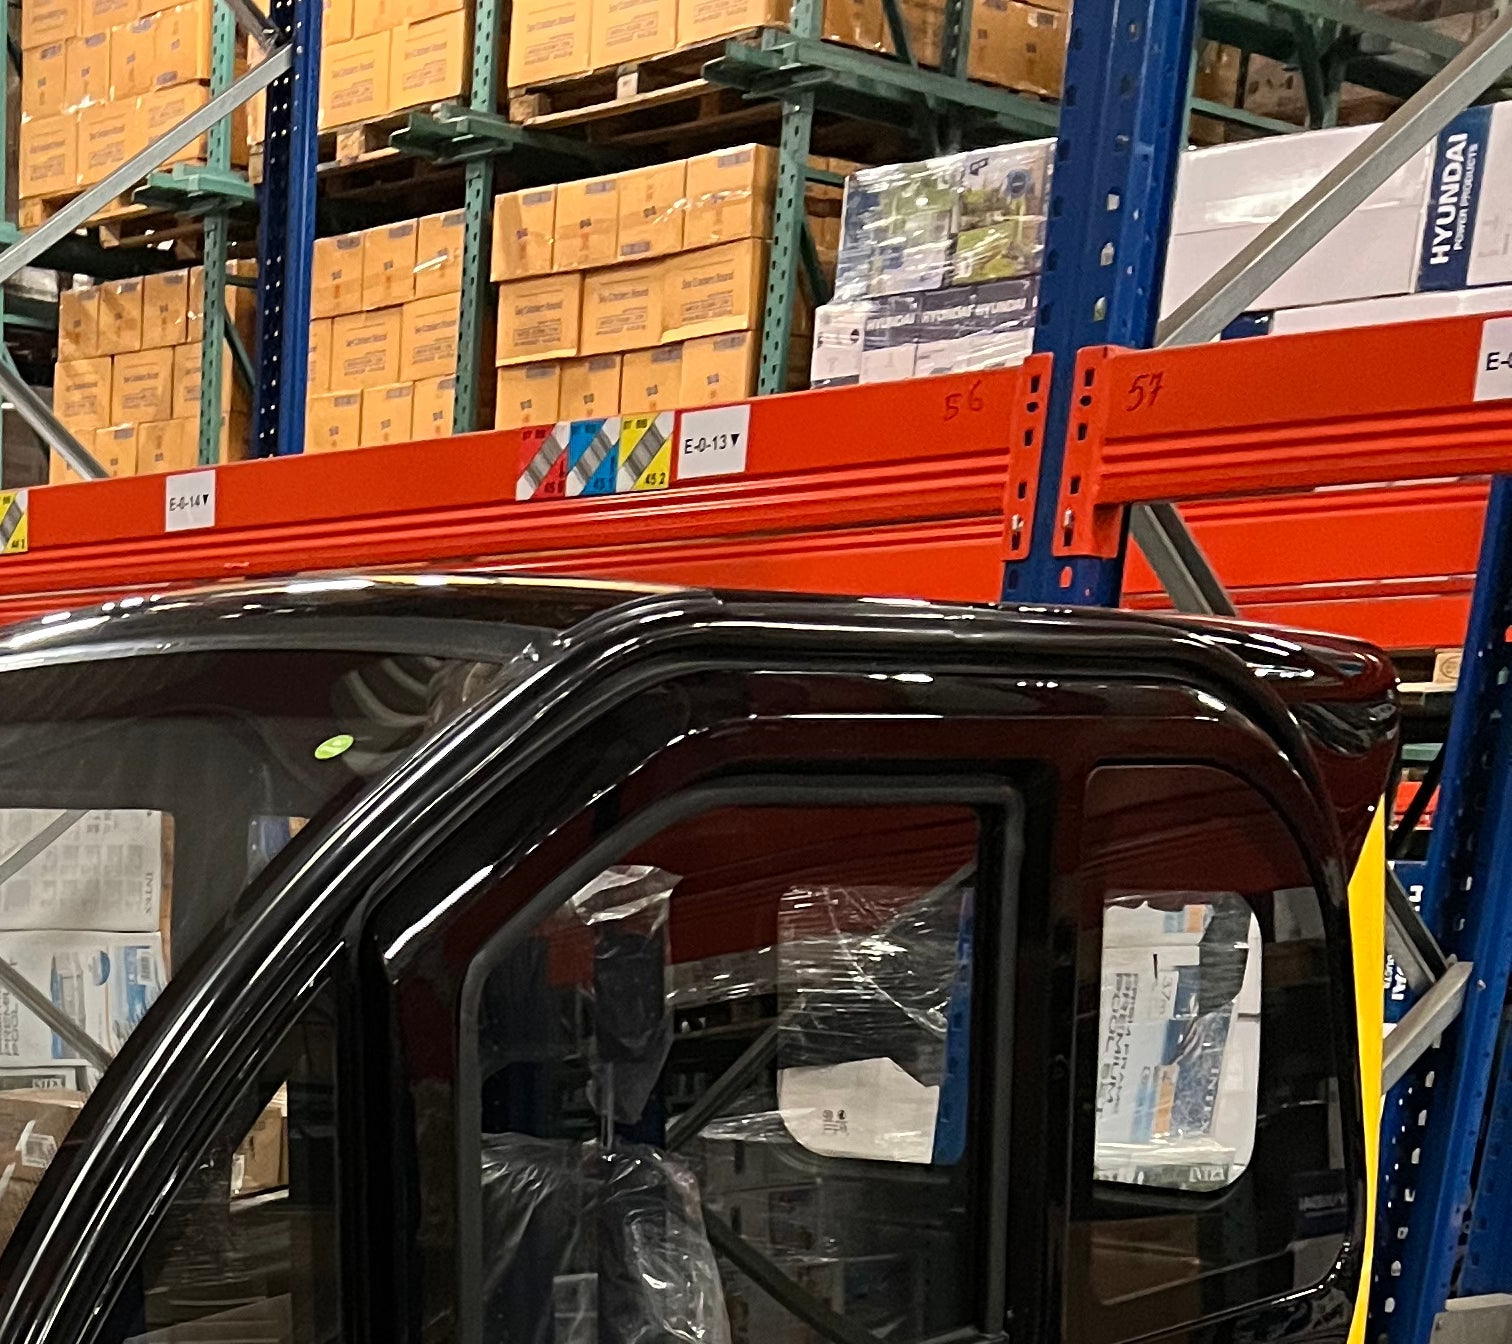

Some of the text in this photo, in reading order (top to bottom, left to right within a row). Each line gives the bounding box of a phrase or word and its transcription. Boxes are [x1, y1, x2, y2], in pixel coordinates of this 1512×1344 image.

[1430, 132, 1468, 265] HYUNDAI
[1127, 371, 1164, 412] 57
[684, 436, 728, 455] E-0-13
